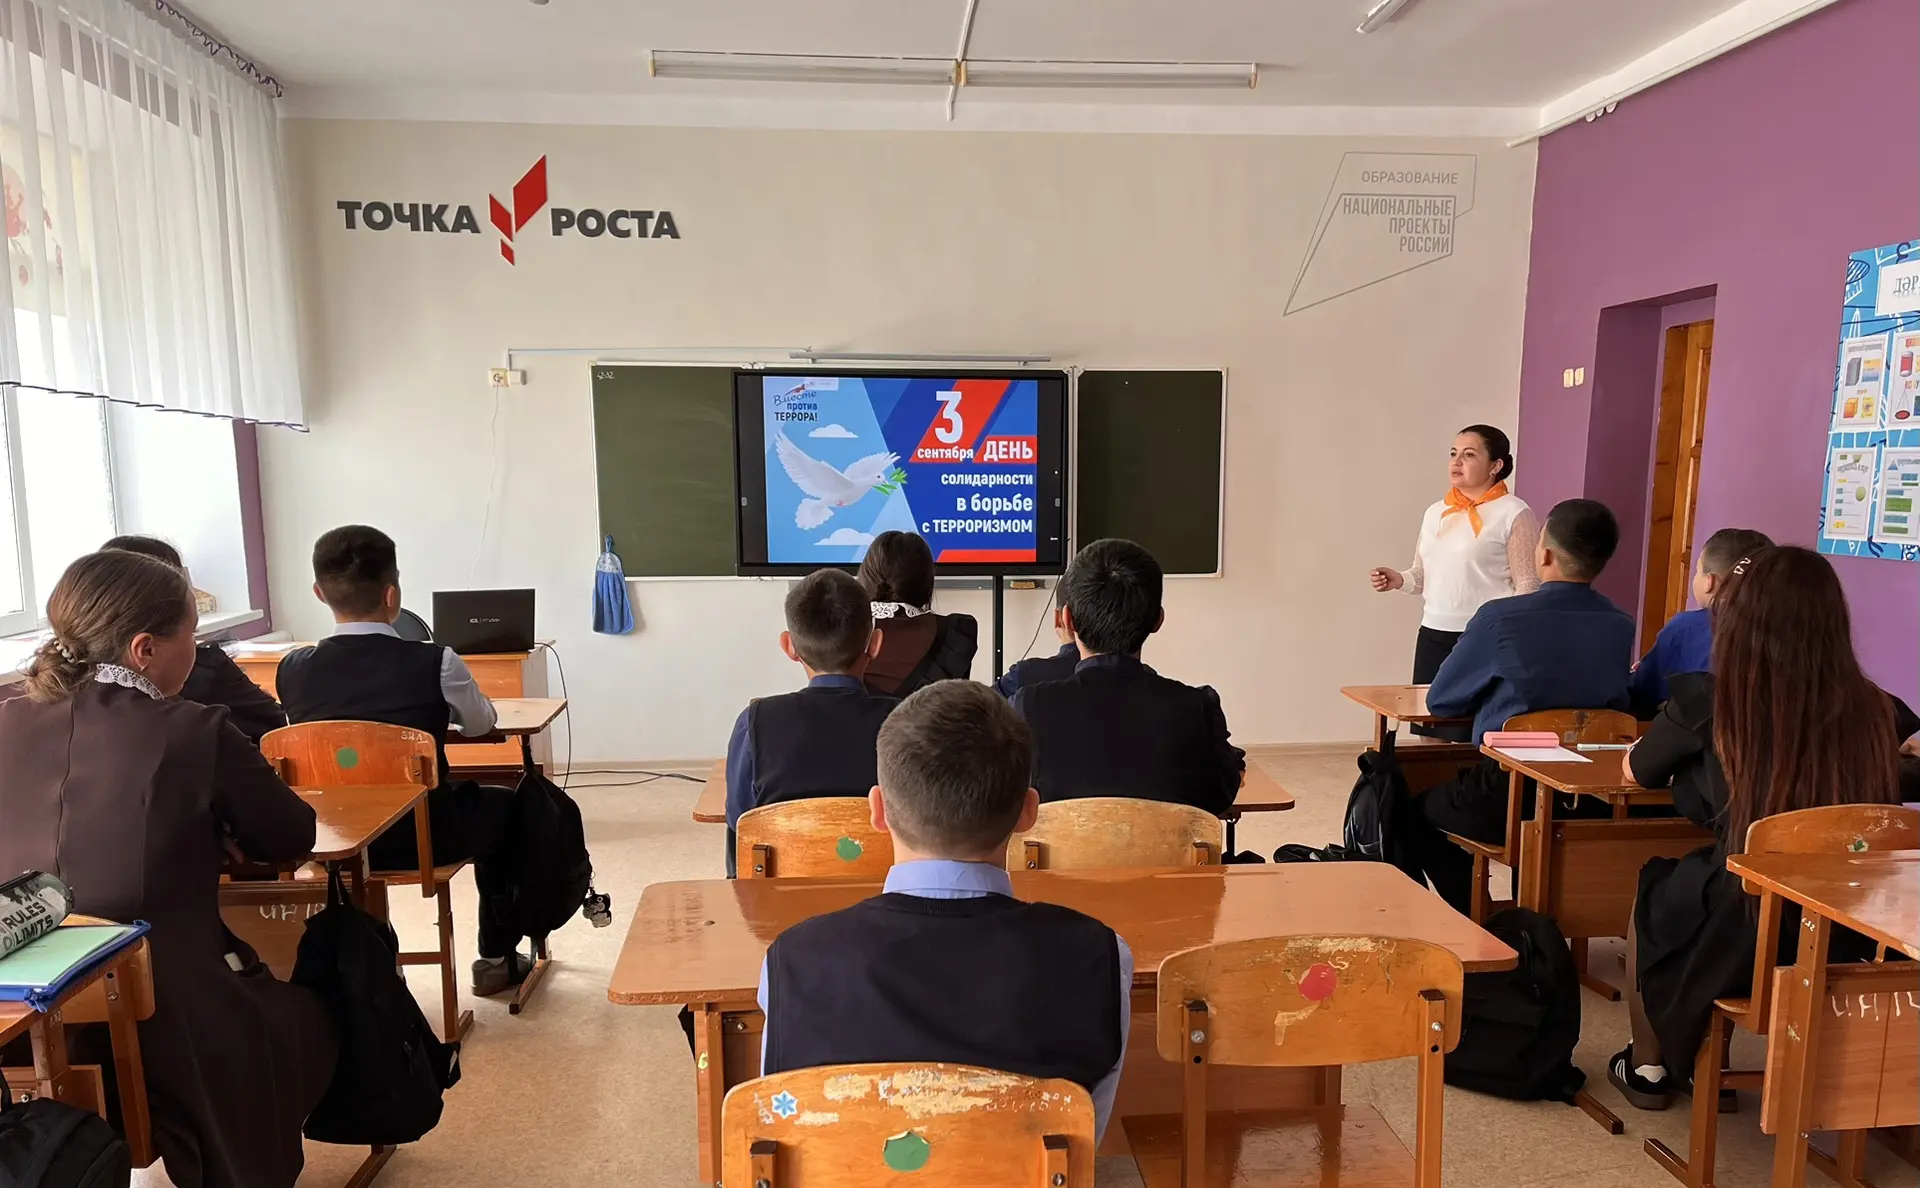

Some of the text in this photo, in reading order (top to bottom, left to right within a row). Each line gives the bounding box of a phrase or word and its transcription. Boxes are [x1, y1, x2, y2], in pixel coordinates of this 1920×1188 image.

[1361, 170, 1458, 185] ОБРАЗОВАНИЕ
[1343, 197, 1453, 217] НАЦИОНАЛЬНЫЕ
[336, 200, 681, 240] ТОЧКА РОСТА
[1389, 217, 1451, 235] ПРОЕКТЫ
[1399, 235, 1450, 253] РОССИИ
[1893, 275, 1920, 295] ДӘР
[773, 391, 817, 406] Вместе
[787, 402, 818, 412] против
[774, 411, 818, 422] ТЕРРОРА!
[934, 390, 963, 444] 3
[917, 440, 1033, 461] сентября ДЕНЬ
[941, 473, 1033, 488] солидарности
[956, 493, 1033, 515] в борьбе
[922, 519, 1033, 533] с ТЕРРОРИЗМОМ
[2, 901, 46, 929] RULES
[14, 914, 54, 945] LIMITS
